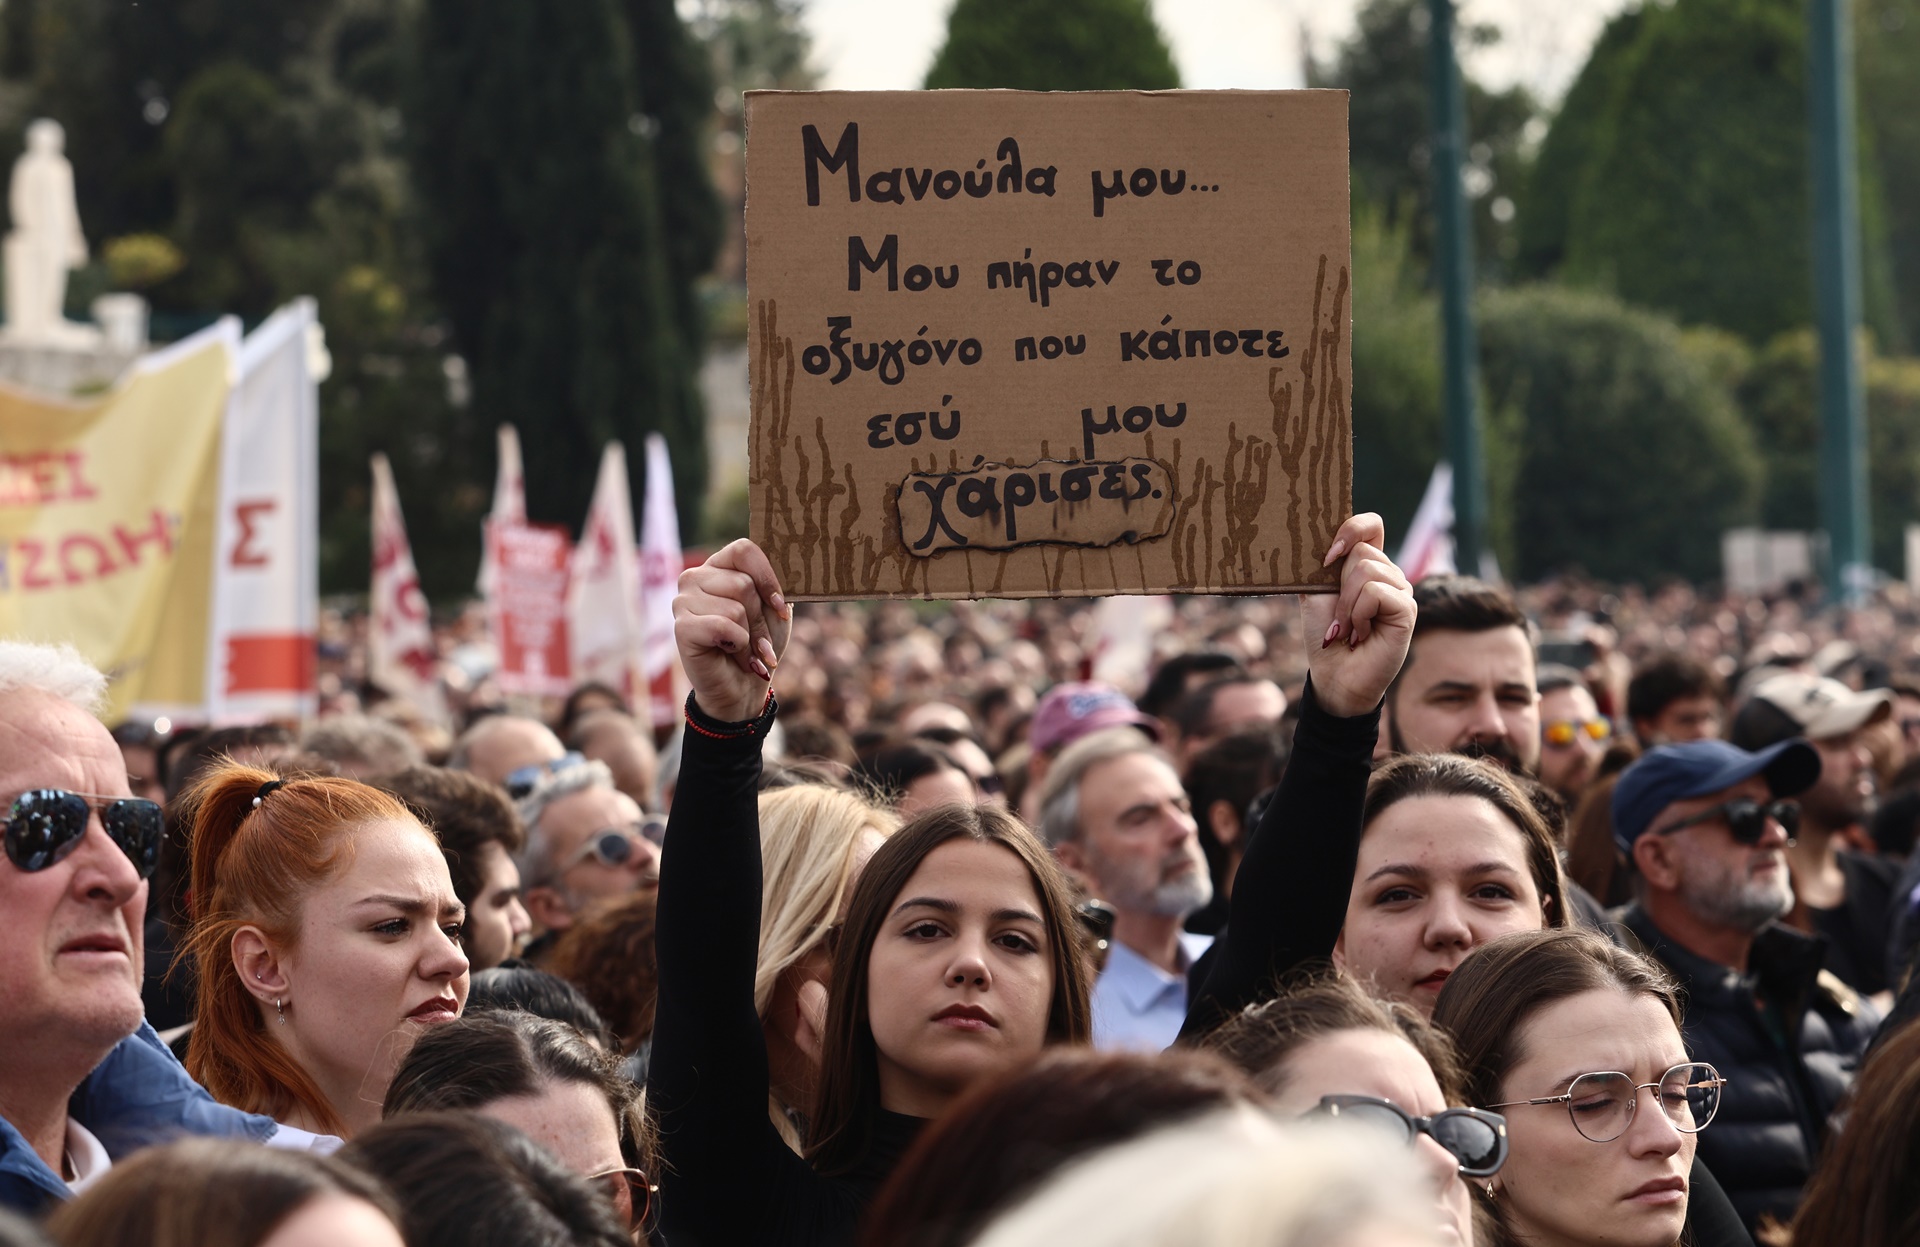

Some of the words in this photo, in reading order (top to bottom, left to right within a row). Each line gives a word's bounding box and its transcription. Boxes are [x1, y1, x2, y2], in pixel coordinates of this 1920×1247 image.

[801, 121, 1058, 206] Μανούλα
[1091, 167, 1220, 218] μου...
[847, 234, 960, 292] Μου
[986, 247, 1121, 308] πήραν
[1150, 259, 1202, 287] το
[801, 315, 983, 386] οξυγόνο
[1014, 334, 1087, 362] που
[1119, 313, 1290, 362] κάποτε
[866, 394, 961, 449] εσύ
[1080, 402, 1187, 460] μου
[912, 455, 1162, 549] χάρισες.
